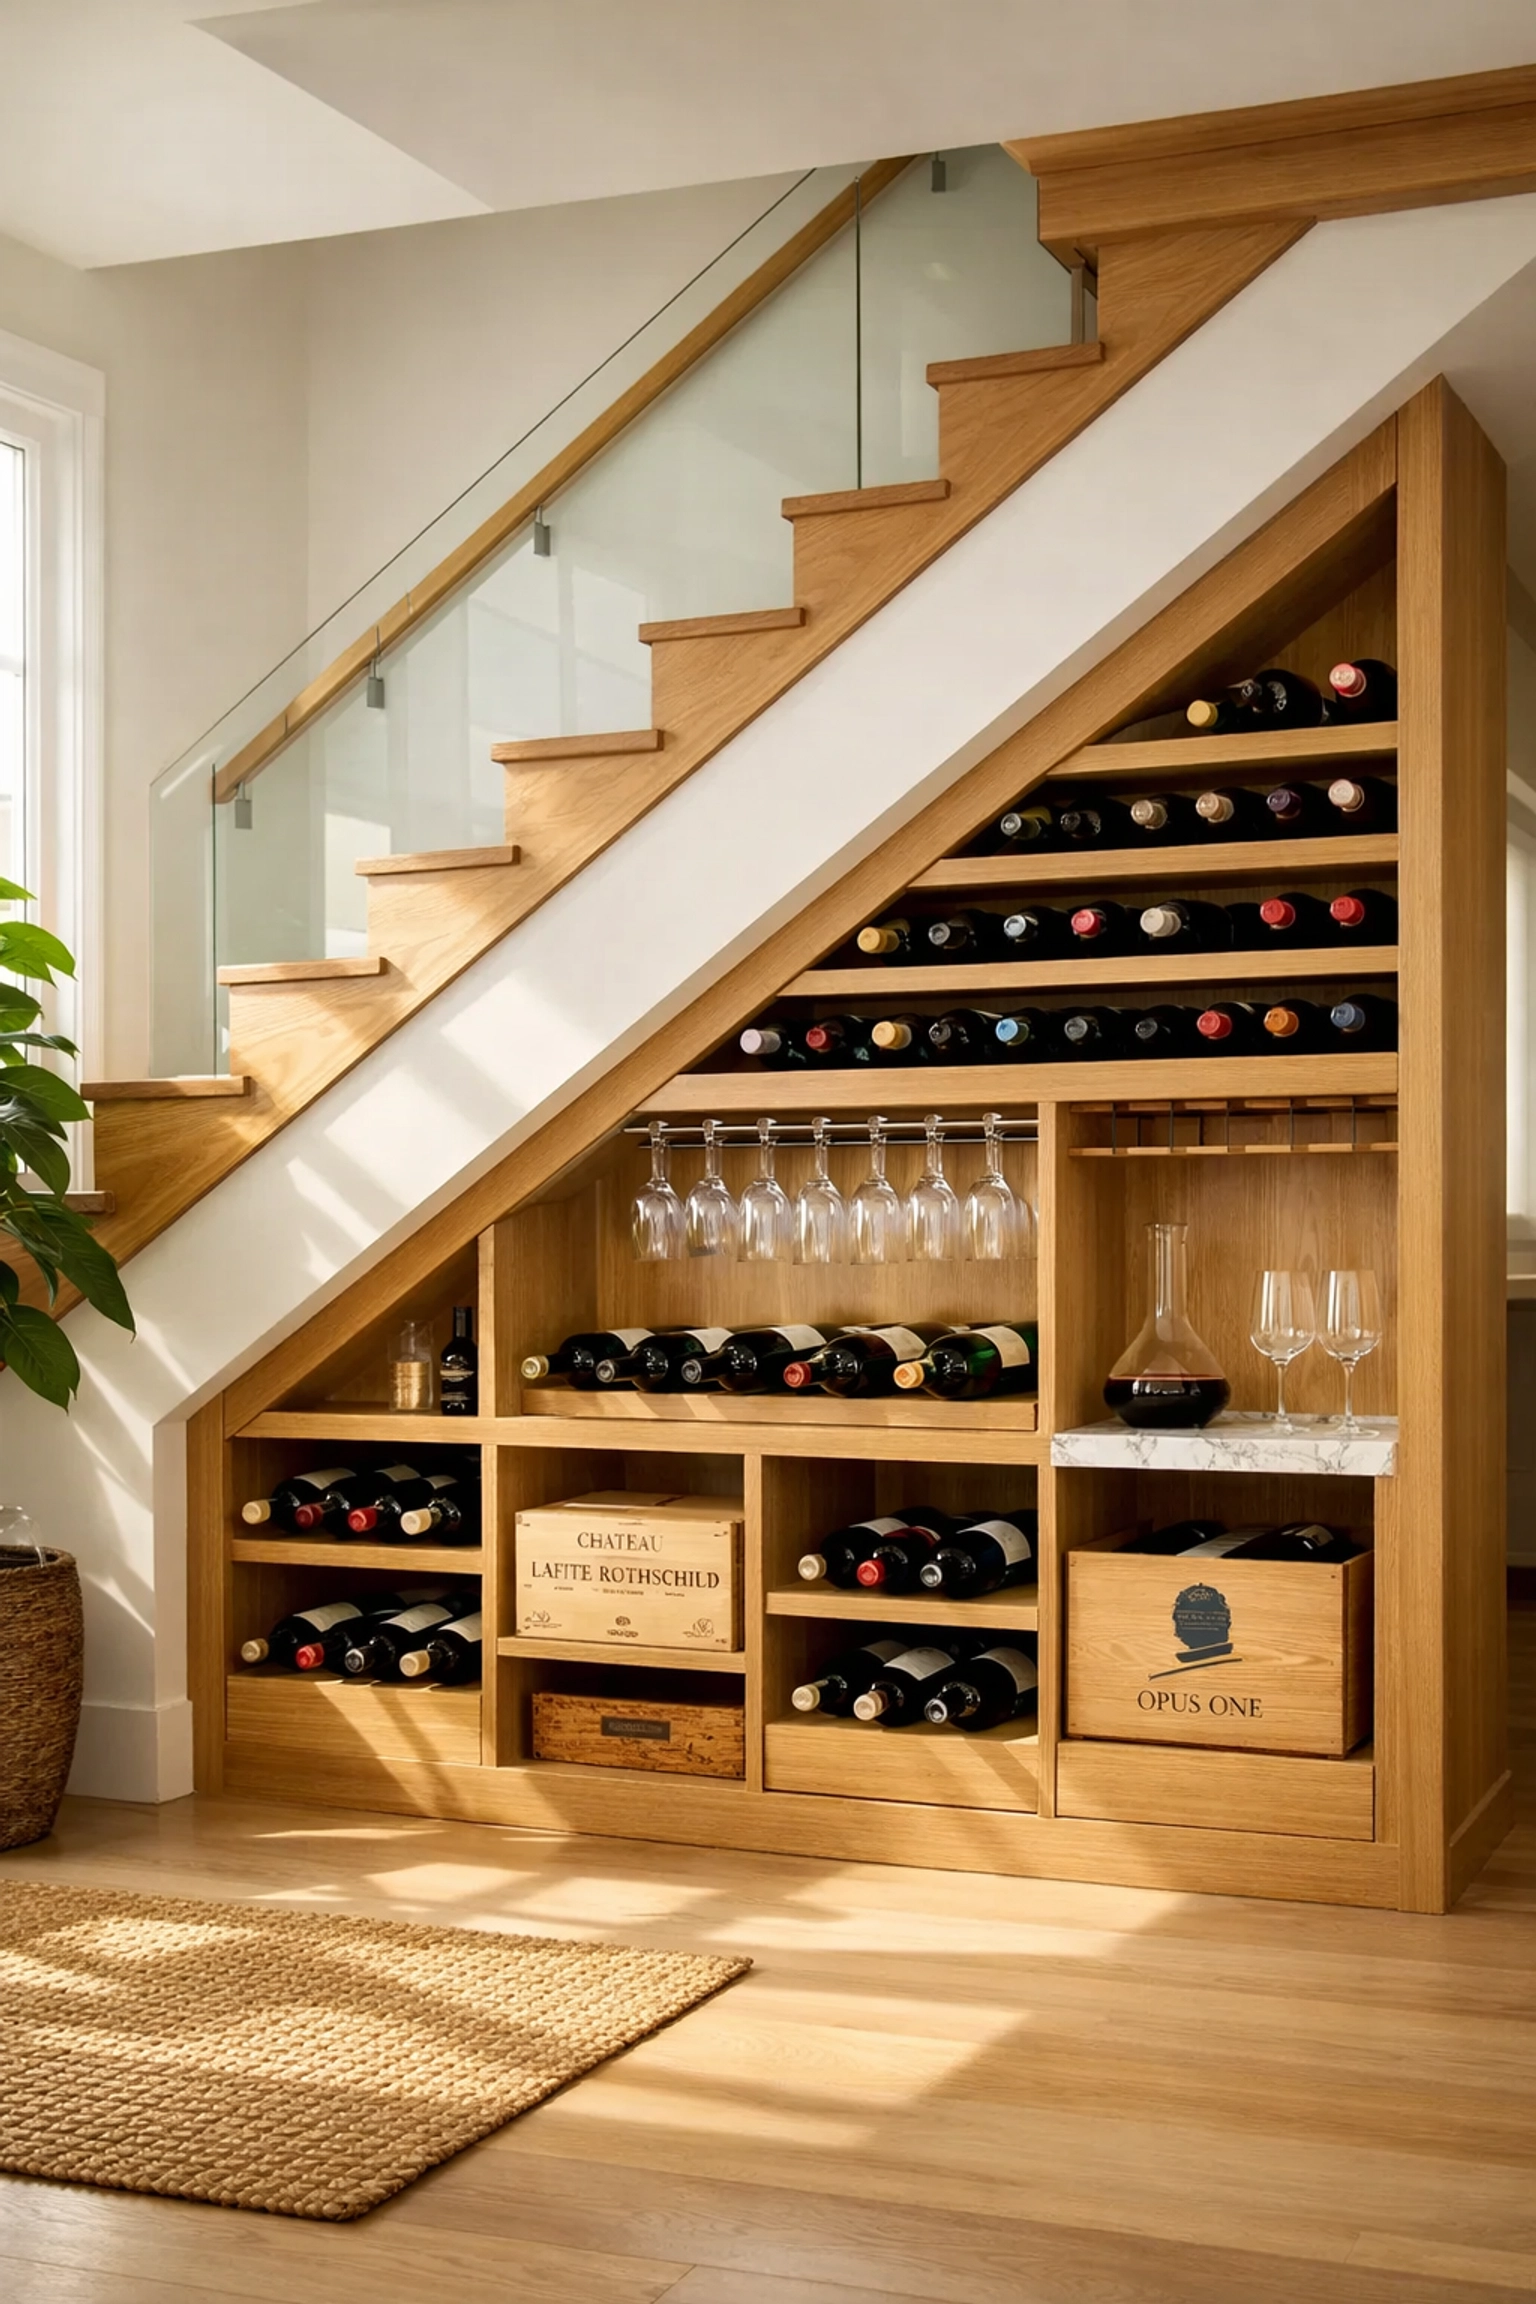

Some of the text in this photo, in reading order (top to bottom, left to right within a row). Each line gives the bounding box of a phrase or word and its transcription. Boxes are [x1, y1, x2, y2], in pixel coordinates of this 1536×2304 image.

[577, 1531, 663, 1552] CHATEAU
[532, 1561, 720, 1588] LAFITE ROTHSCHILD
[1137, 1690, 1263, 1718] OPUS ONE
